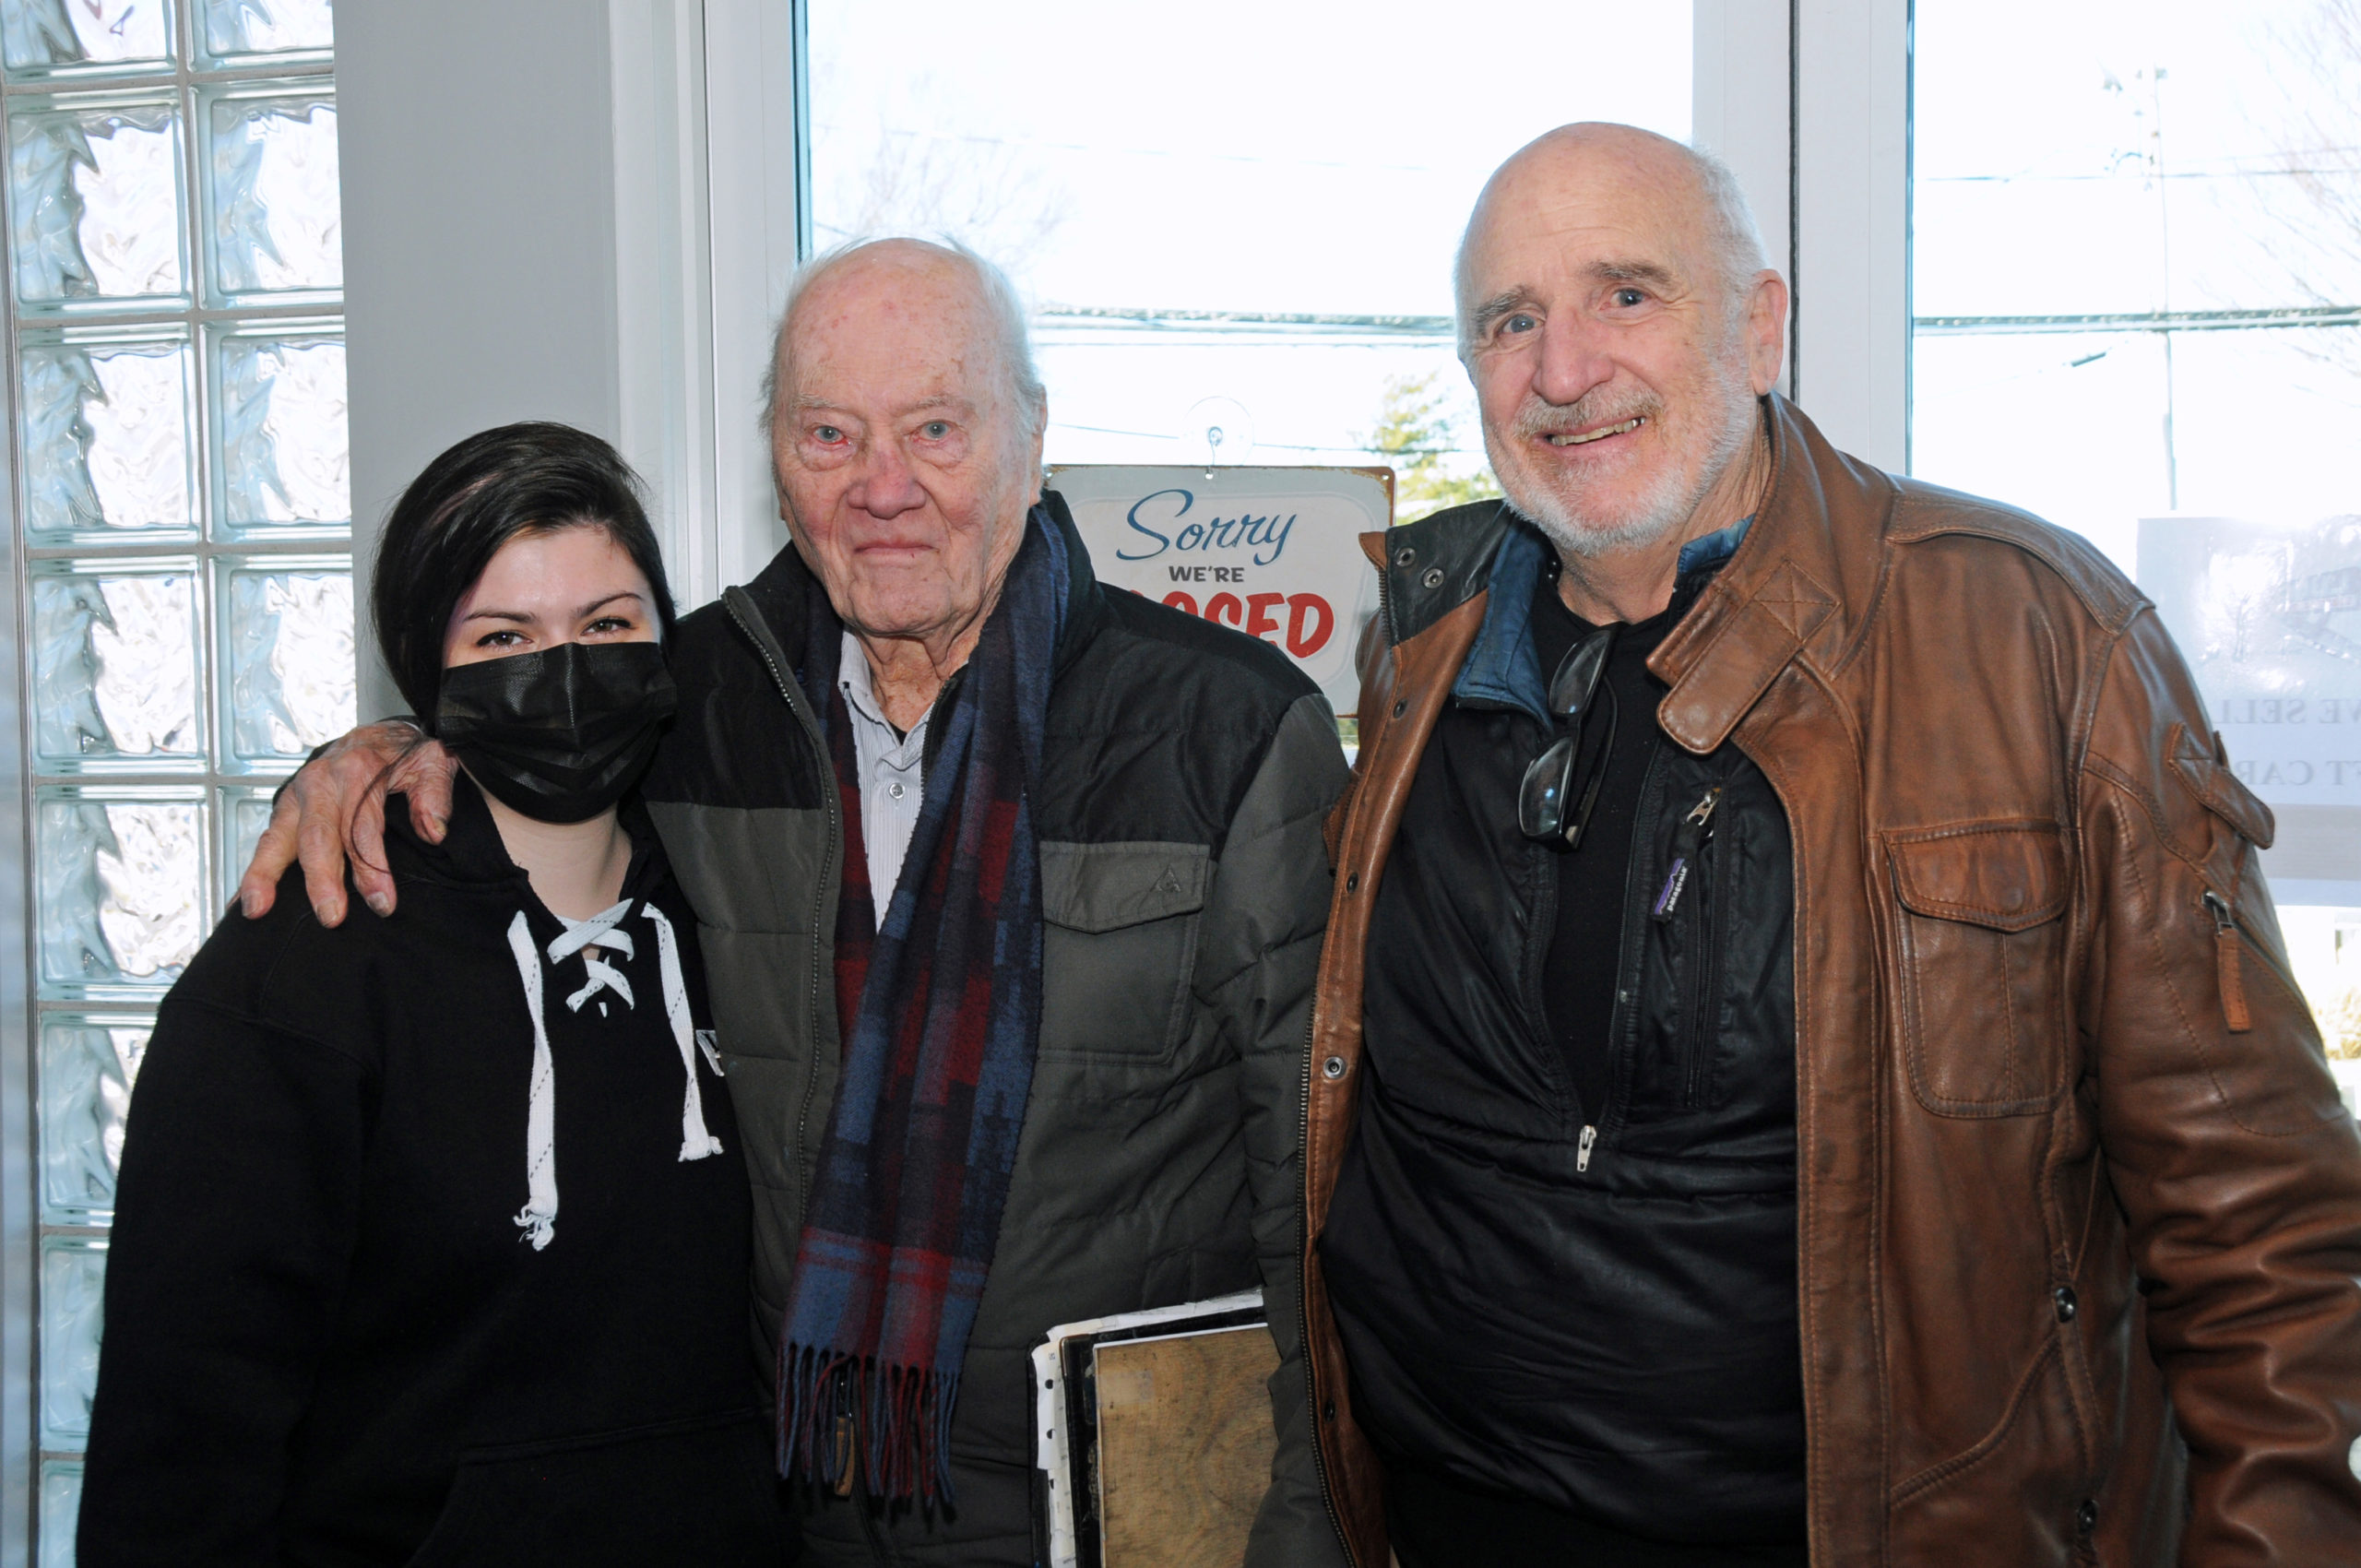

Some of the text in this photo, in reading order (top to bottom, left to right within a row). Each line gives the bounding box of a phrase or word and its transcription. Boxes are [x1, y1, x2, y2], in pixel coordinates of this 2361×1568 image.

[1116, 489, 1298, 566] Sorry
[1169, 565, 1244, 583] WE'RE
[1667, 865, 1689, 912] patagonia
